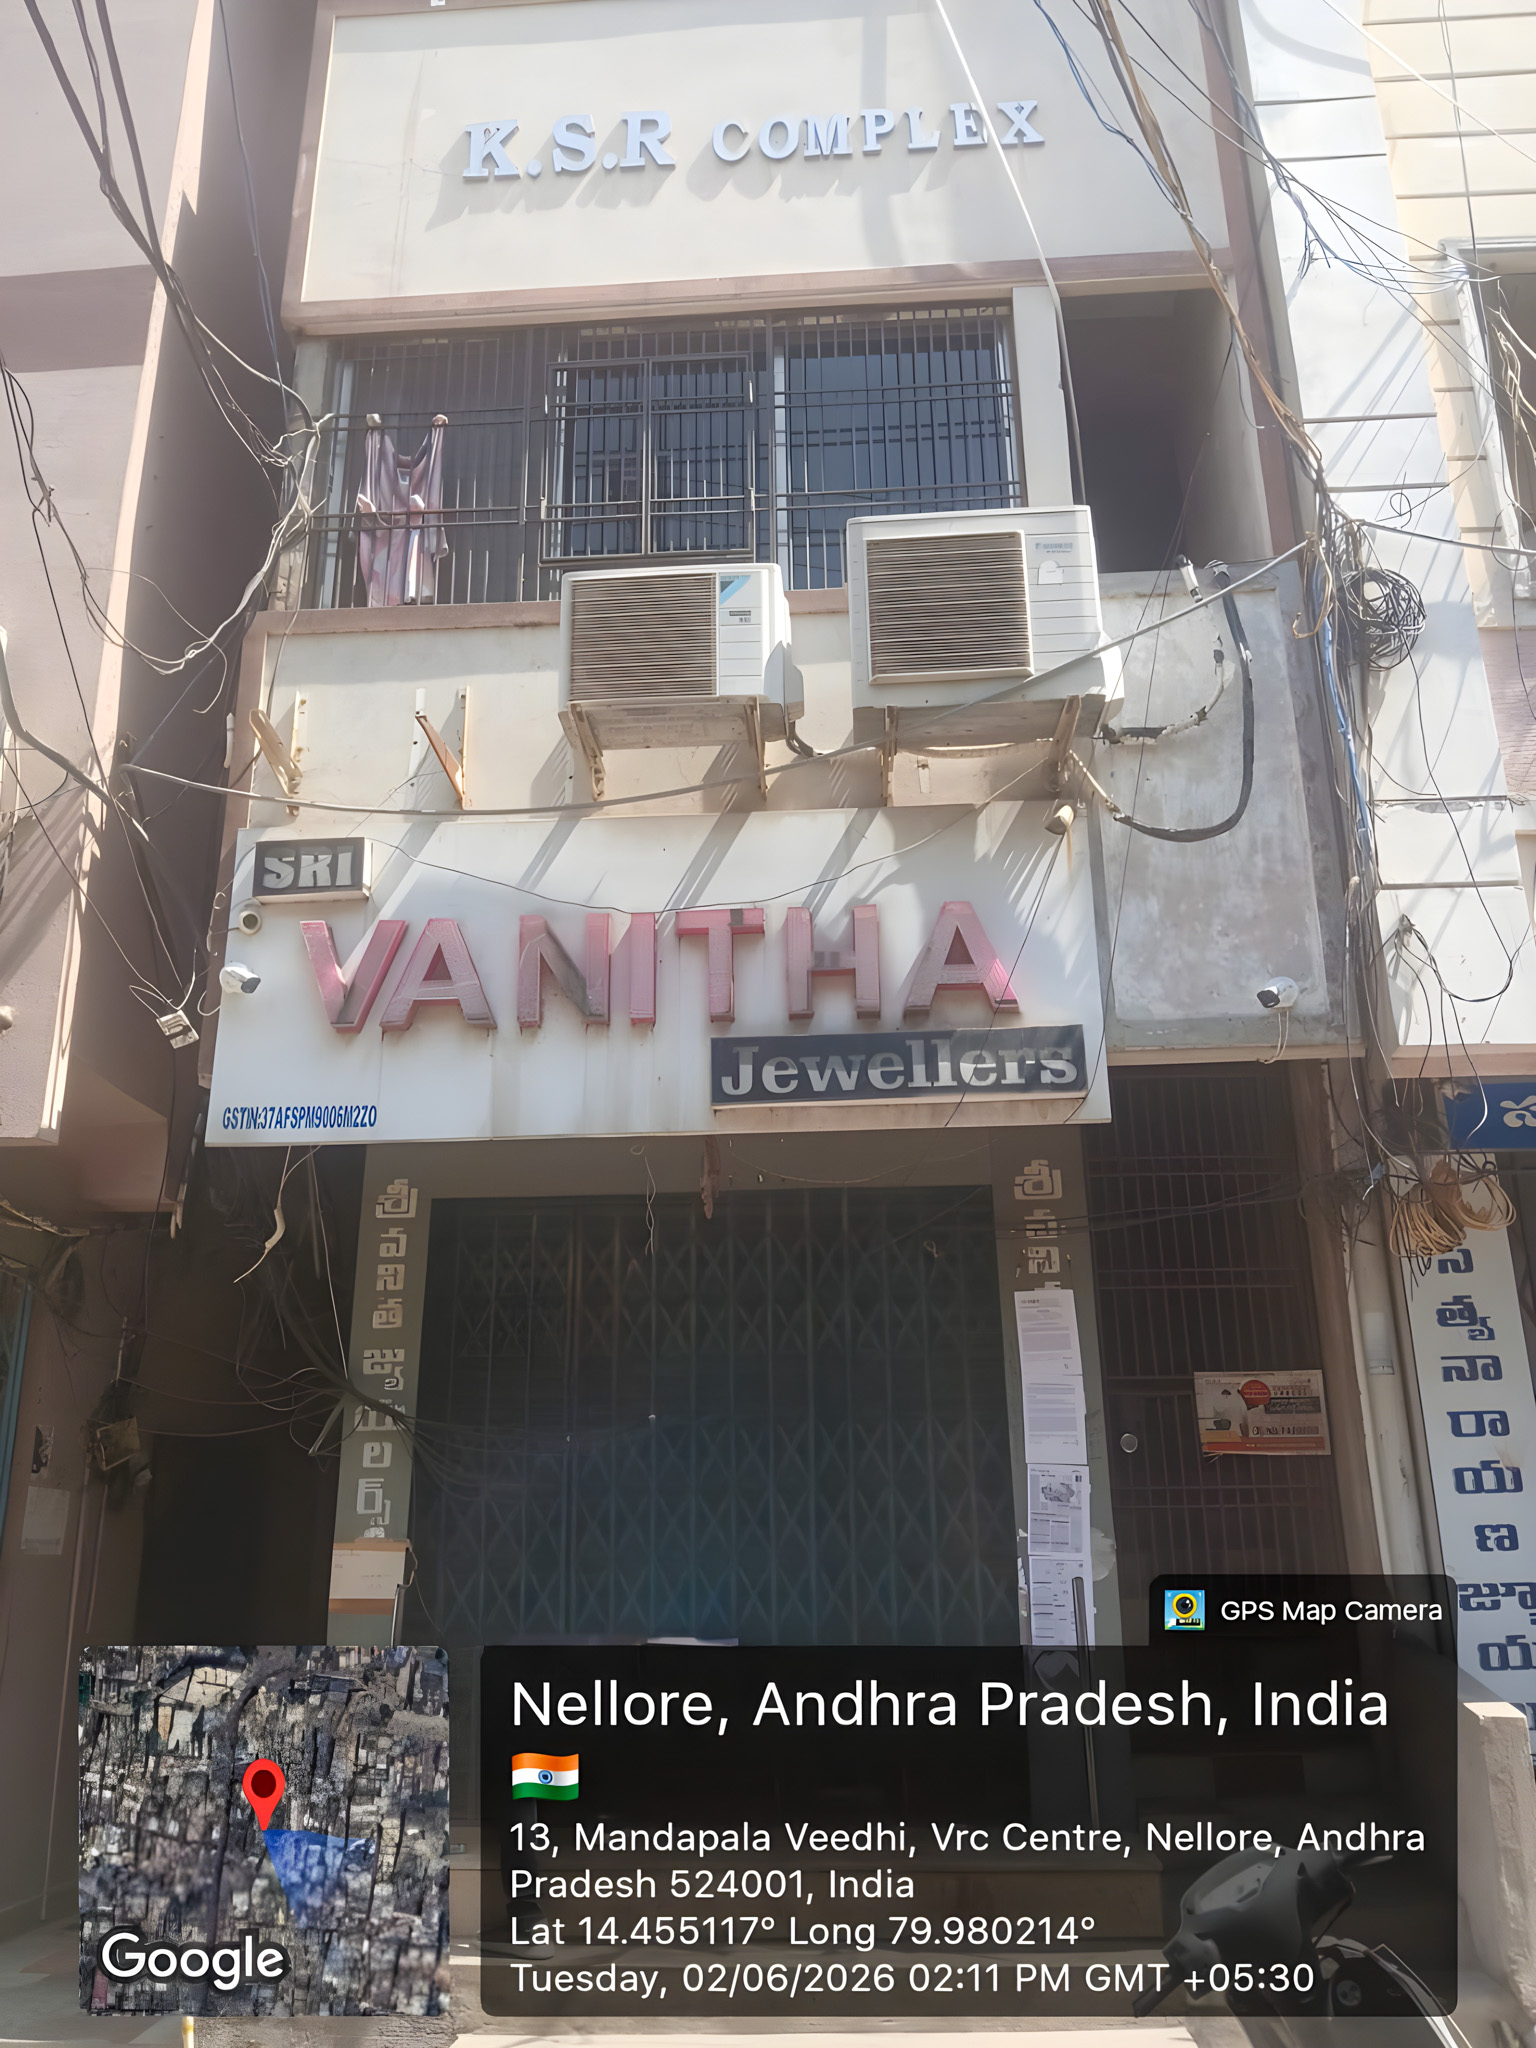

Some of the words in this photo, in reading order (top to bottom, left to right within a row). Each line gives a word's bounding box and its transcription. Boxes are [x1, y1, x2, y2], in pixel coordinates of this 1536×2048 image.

[463, 111, 675, 178] K.S.R
[712, 100, 1046, 162] COMPLEX
[262, 845, 355, 888] SRI
[300, 901, 1020, 1033] VANITHA
[721, 1039, 1079, 1096] Jewellers
